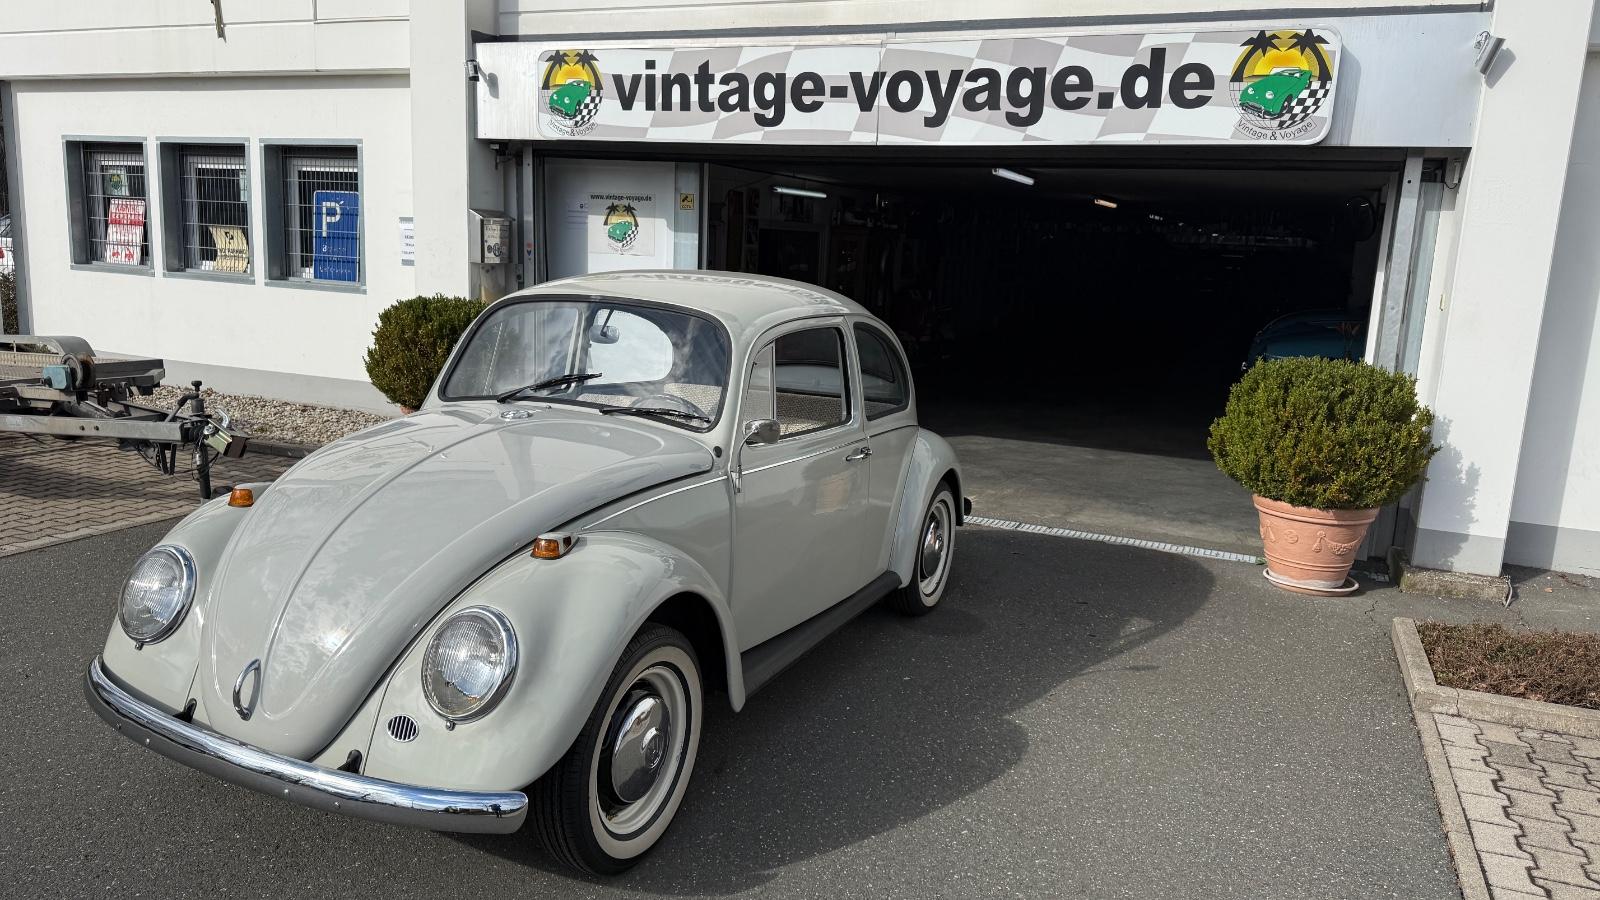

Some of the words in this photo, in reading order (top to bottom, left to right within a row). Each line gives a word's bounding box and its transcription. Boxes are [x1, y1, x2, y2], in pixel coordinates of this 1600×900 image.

[612, 48, 1214, 128] vintage-voyage.de
[549, 120, 570, 136] Vintage
[576, 122, 596, 135] Voyage
[1238, 120, 1268, 139] Vintage
[1270, 132, 1278, 140] &
[1279, 122, 1313, 139] Voyage
[590, 194, 652, 202] www.vintage-voyage.de
[322, 202, 341, 237] P
